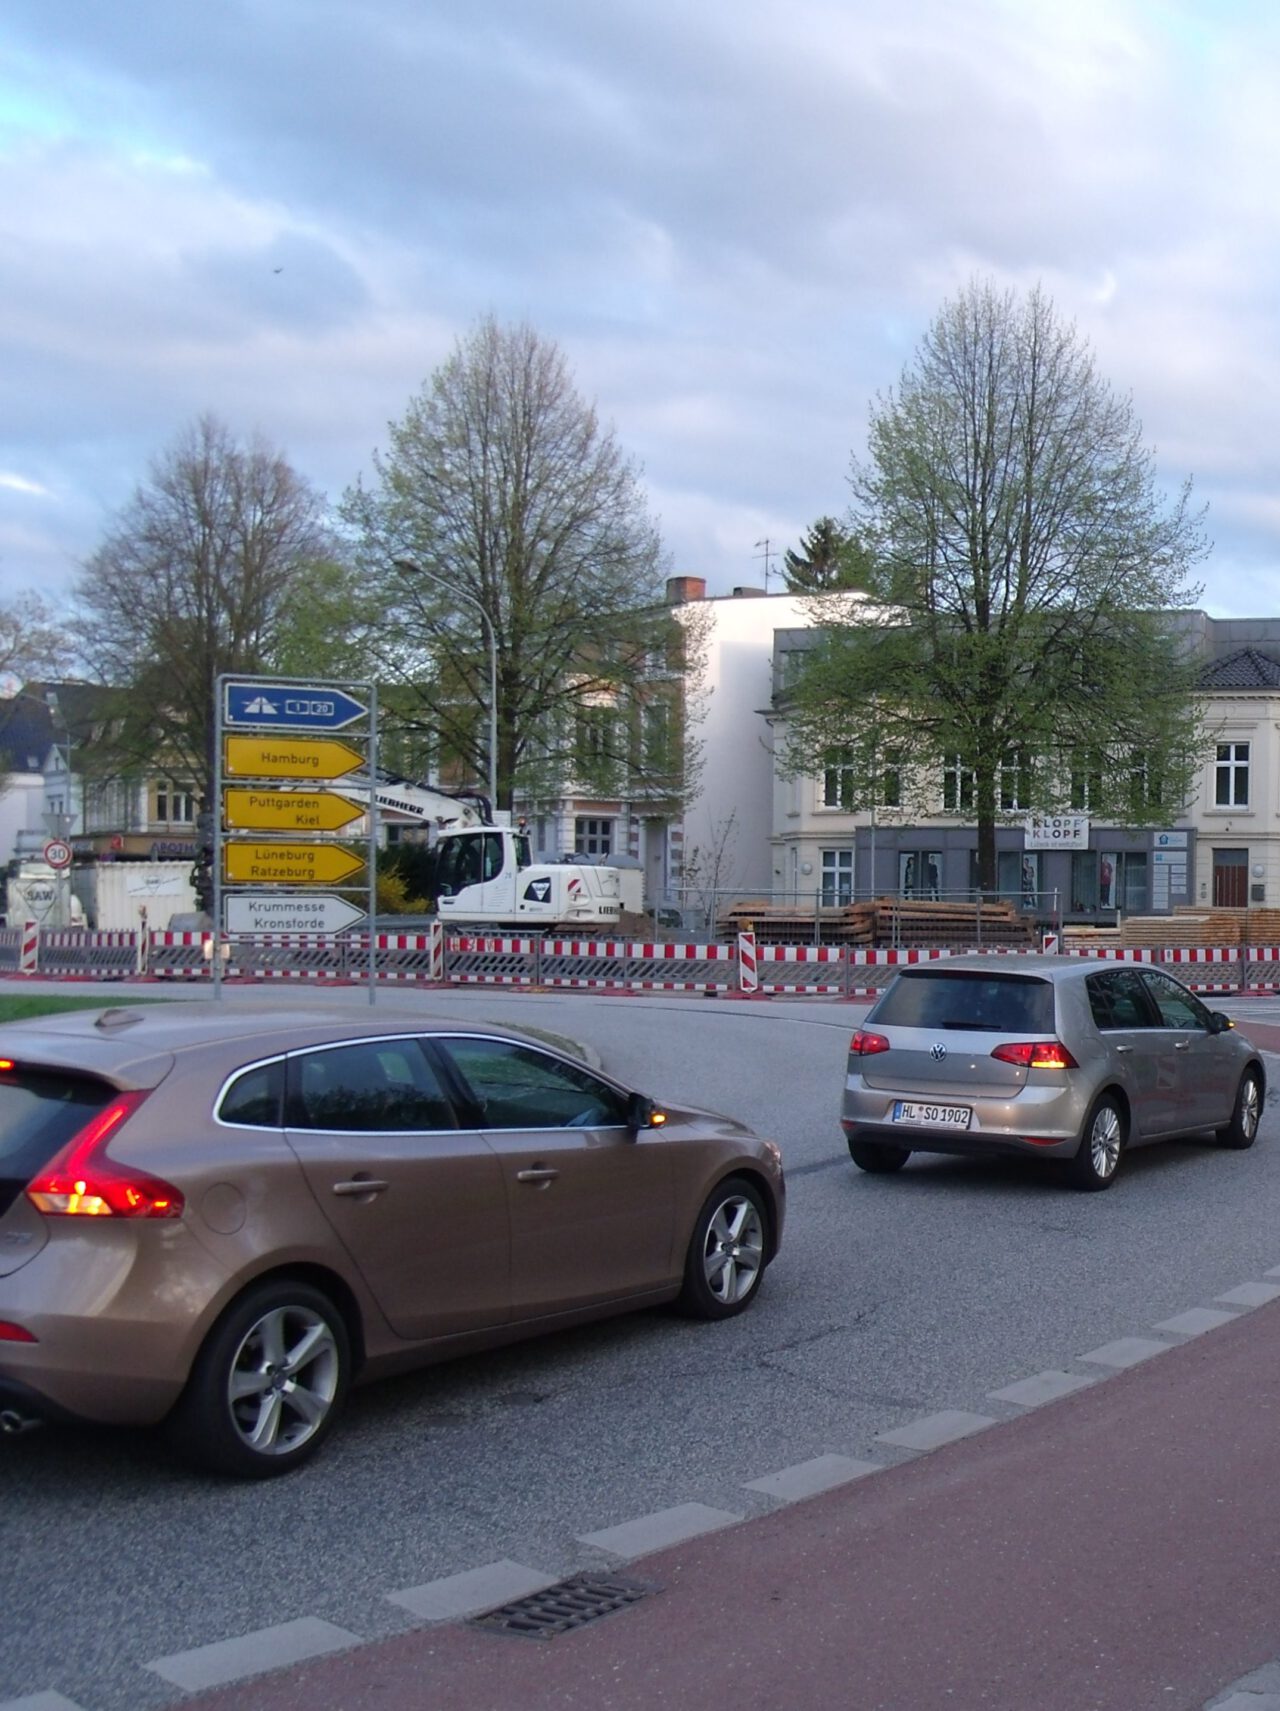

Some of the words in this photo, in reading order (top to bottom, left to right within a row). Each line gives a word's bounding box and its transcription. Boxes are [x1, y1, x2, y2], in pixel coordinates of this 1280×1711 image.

[316, 704, 329, 713] 20
[261, 752, 320, 767] Hamburg
[249, 796, 320, 809] Puttgarden
[296, 815, 320, 826] Kiel
[1032, 818, 1081, 829] KLOPF
[1033, 829, 1080, 838] KLOPF
[50, 848, 66, 860] 30
[255, 850, 316, 862] Lüneburg
[251, 866, 316, 879] Ratzeburg
[248, 901, 326, 912] Krummesse
[254, 918, 326, 929] Kronsforde
[902, 1105, 915, 1119] HL
[924, 1107, 938, 1120] SO
[940, 1109, 968, 1123] 1902
